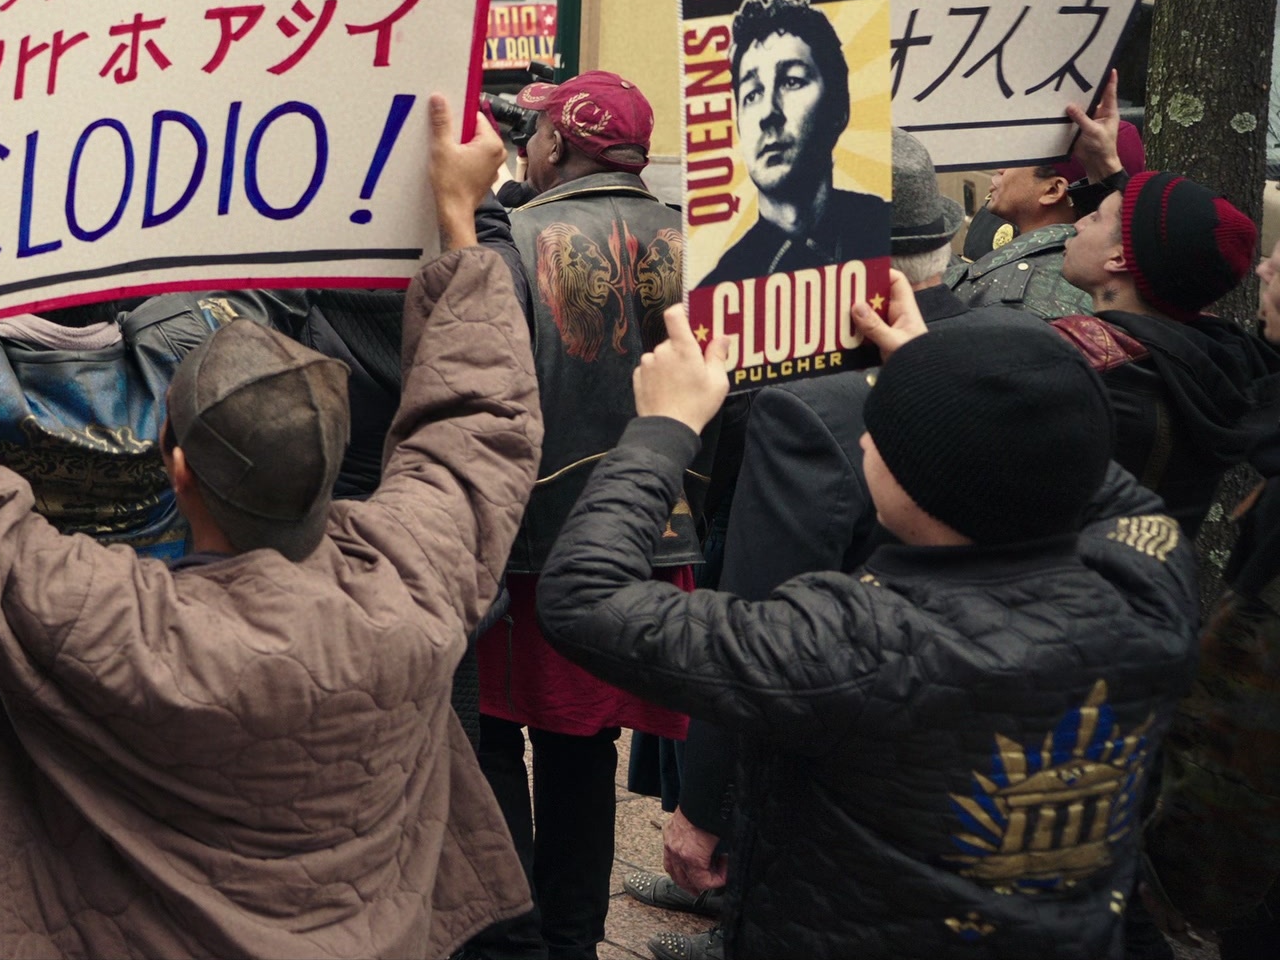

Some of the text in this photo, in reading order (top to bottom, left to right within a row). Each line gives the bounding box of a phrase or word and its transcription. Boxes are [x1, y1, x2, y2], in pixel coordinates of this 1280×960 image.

[505, 34, 556, 61] RALLY
[683, 24, 741, 228] QUEENS
[712, 259, 868, 373] CLODIO
[734, 351, 844, 386] PULCHER
